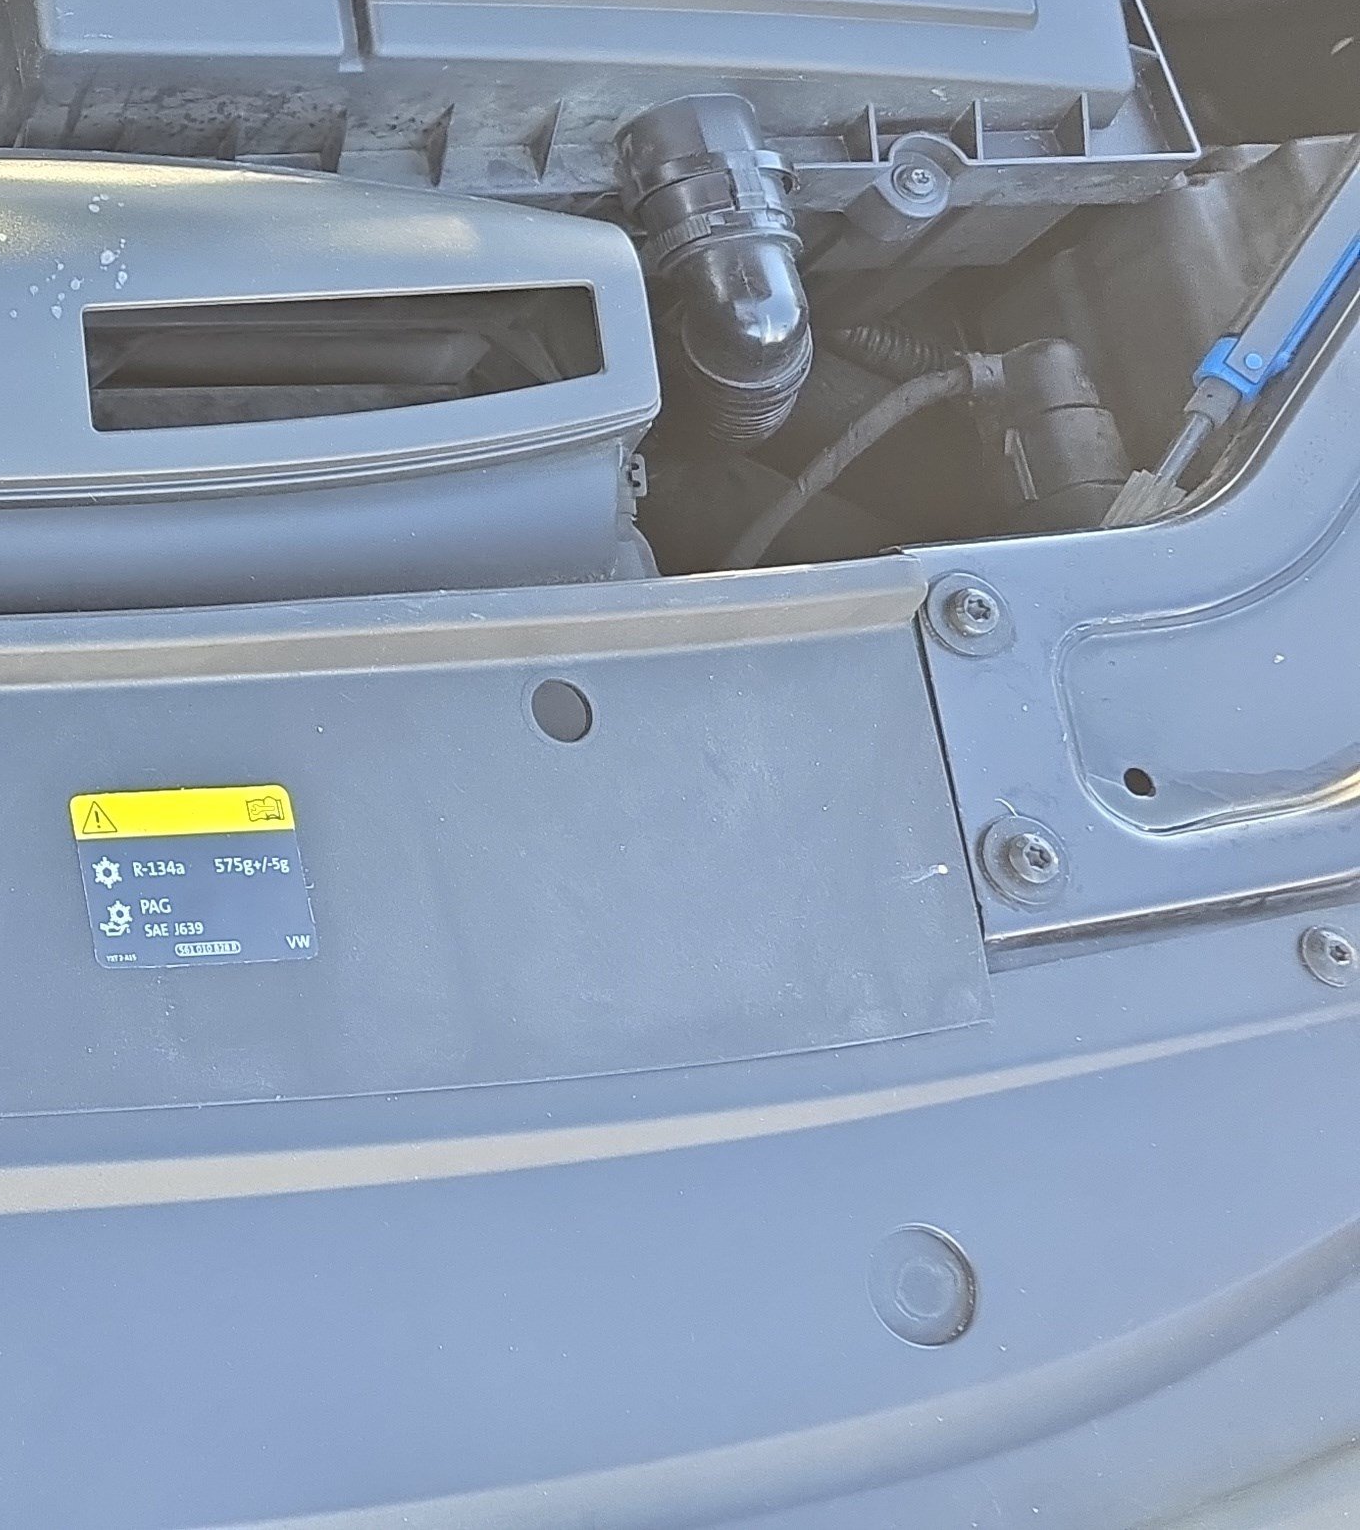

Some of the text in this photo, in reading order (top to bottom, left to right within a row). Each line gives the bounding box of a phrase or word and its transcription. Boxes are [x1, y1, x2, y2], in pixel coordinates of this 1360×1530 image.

[132, 856, 290, 878] R-134a 575g+/-5g
[139, 898, 172, 915] PAG
[144, 922, 204, 937] SAE J639
[285, 935, 311, 950] VW
